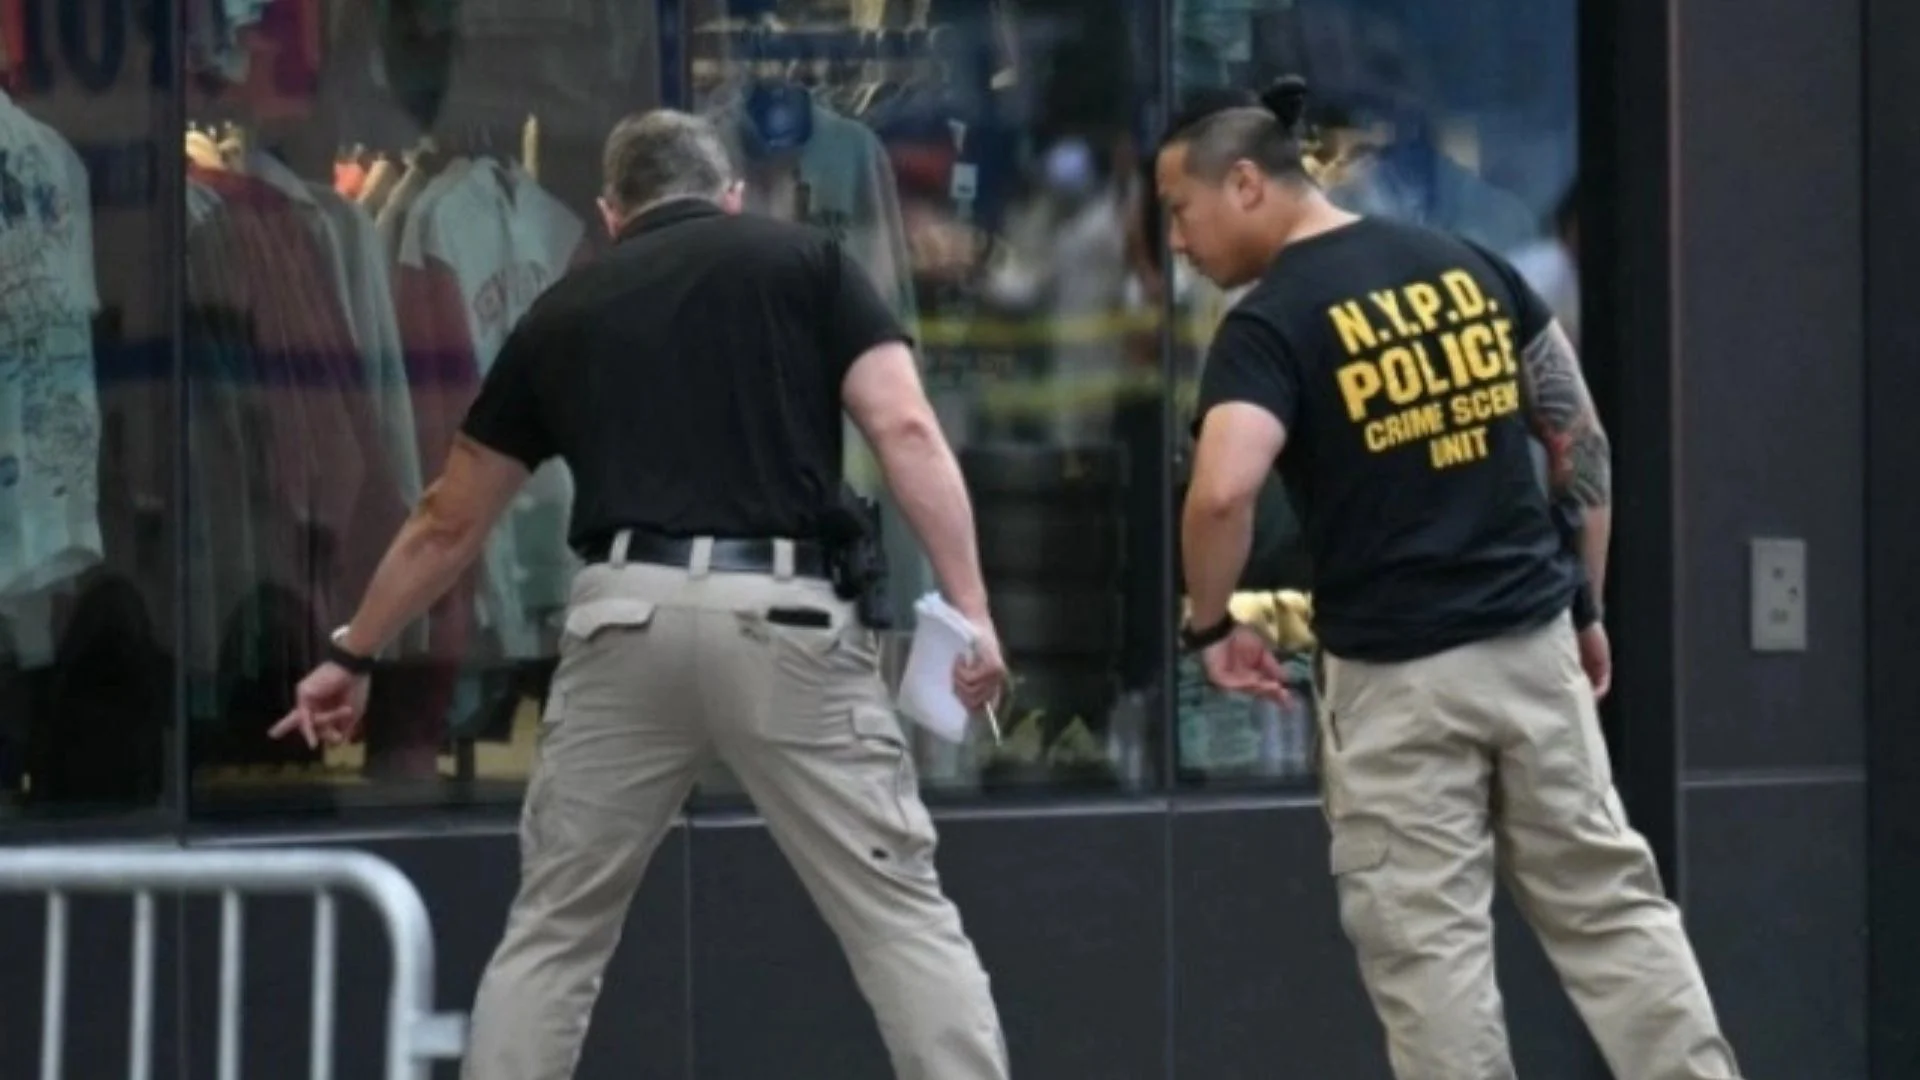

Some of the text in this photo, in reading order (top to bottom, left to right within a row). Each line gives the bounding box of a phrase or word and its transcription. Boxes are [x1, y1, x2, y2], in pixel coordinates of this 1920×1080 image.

[1328, 268, 1499, 354] N.Y.P.D.
[1337, 318, 1517, 421] POLICE
[1364, 380, 1519, 453] CRIME SCEN
[1429, 426, 1488, 469] UNIT
